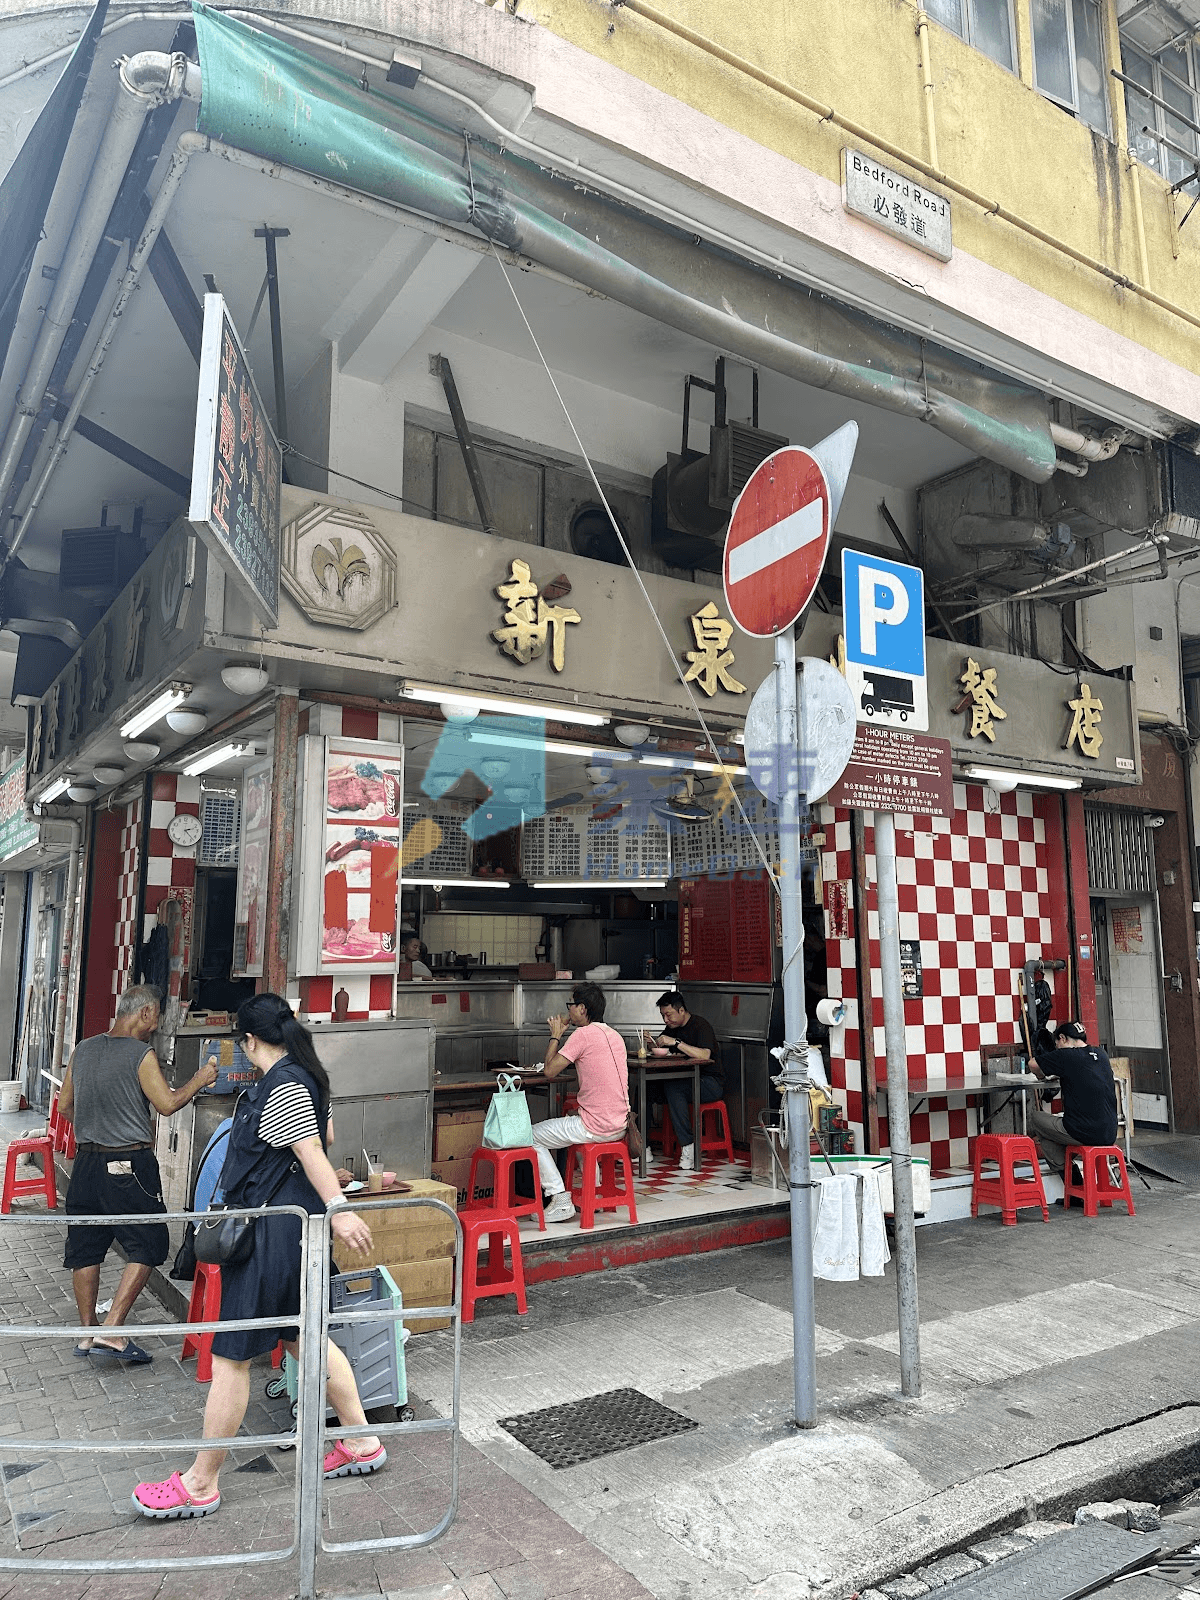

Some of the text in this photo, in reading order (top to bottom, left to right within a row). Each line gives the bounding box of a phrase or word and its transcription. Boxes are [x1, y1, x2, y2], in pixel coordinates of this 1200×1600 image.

[853, 156, 945, 217] Bedford Road
[873, 194, 927, 238] 必發道
[858, 564, 909, 656] P
[865, 728, 915, 743] 1-HOUR METERS
[866, 773, 918, 788] 一小時停車錶
